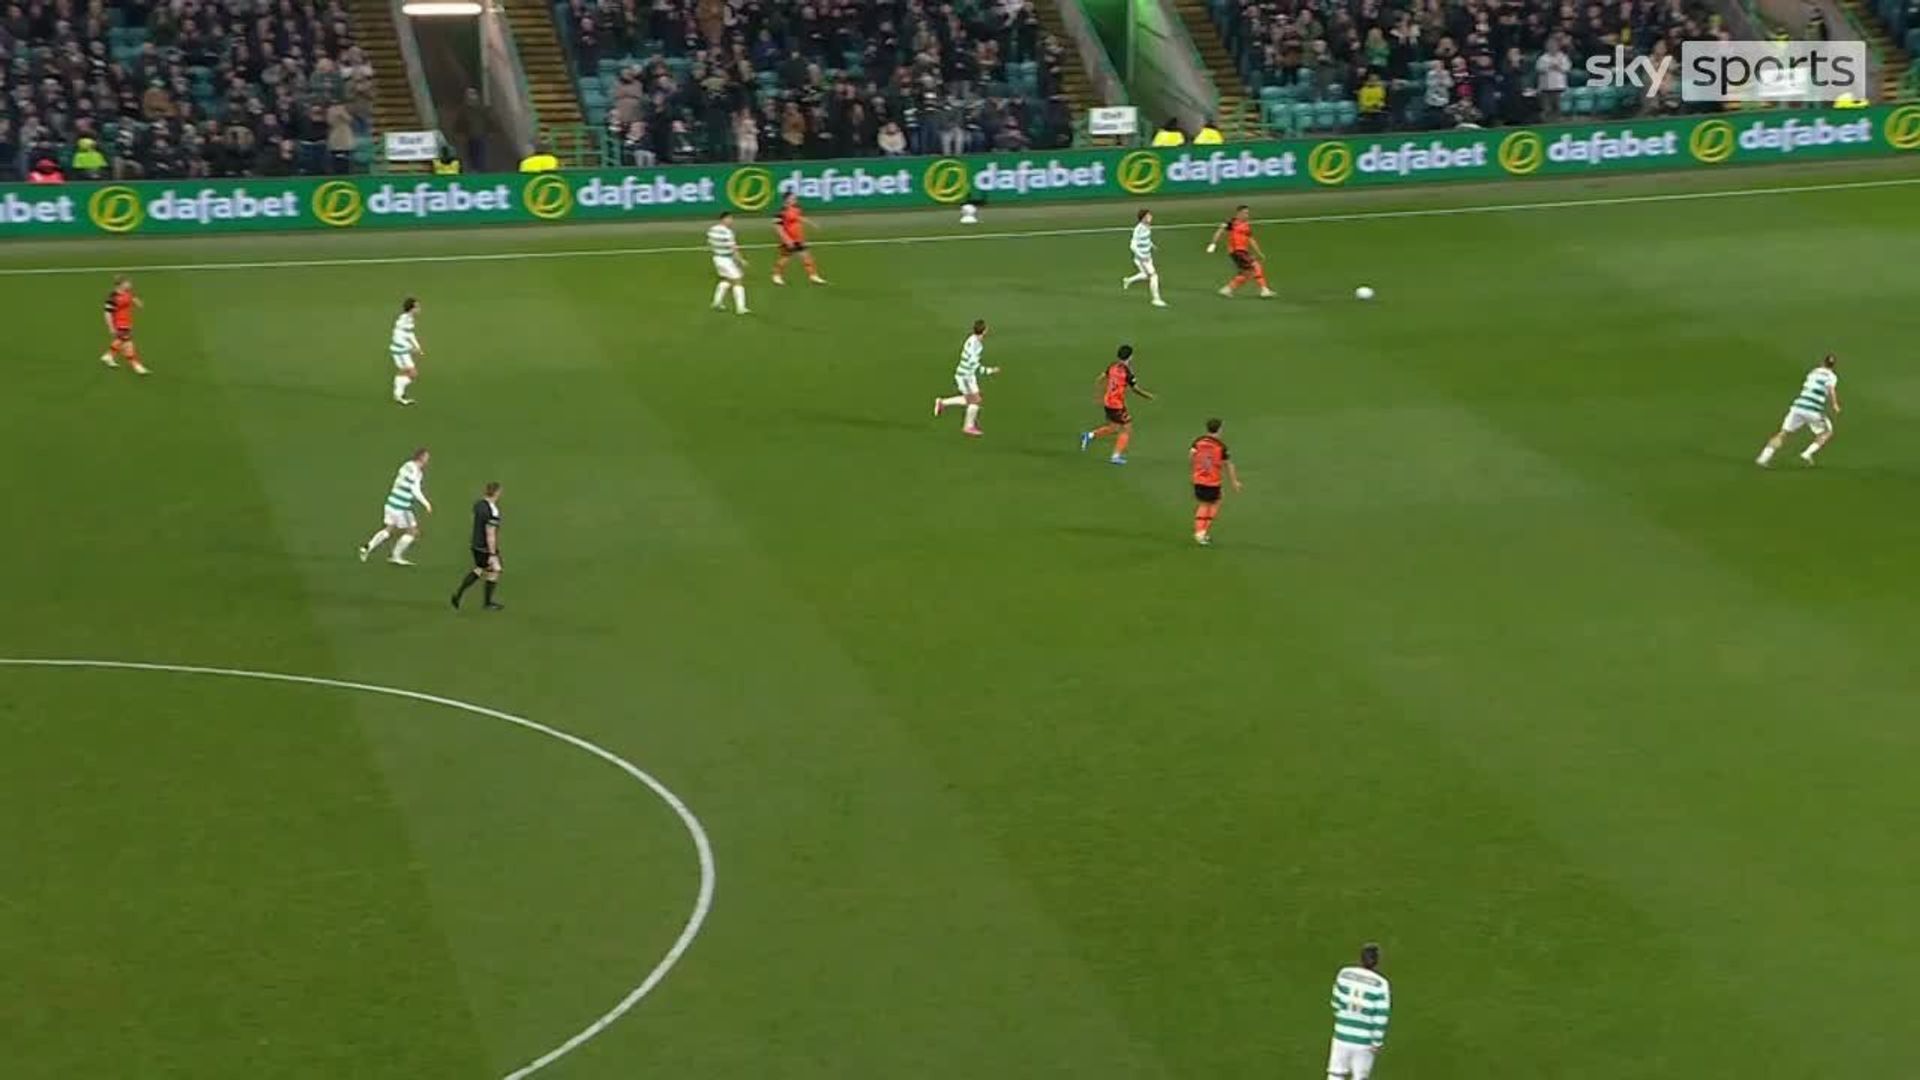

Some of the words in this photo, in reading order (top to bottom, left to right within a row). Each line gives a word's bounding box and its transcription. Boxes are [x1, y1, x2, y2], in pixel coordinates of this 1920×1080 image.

[1547, 130, 1678, 165] dafabet
[1739, 117, 1873, 152] dafabet
[1166, 150, 1296, 185] dafabet
[1356, 141, 1487, 176] dafabet
[576, 175, 715, 210] dafabet
[777, 168, 911, 204] dafabet
[974, 159, 1105, 194] dafabet
[147, 188, 298, 224] dafabet
[367, 182, 511, 217] dafabet
